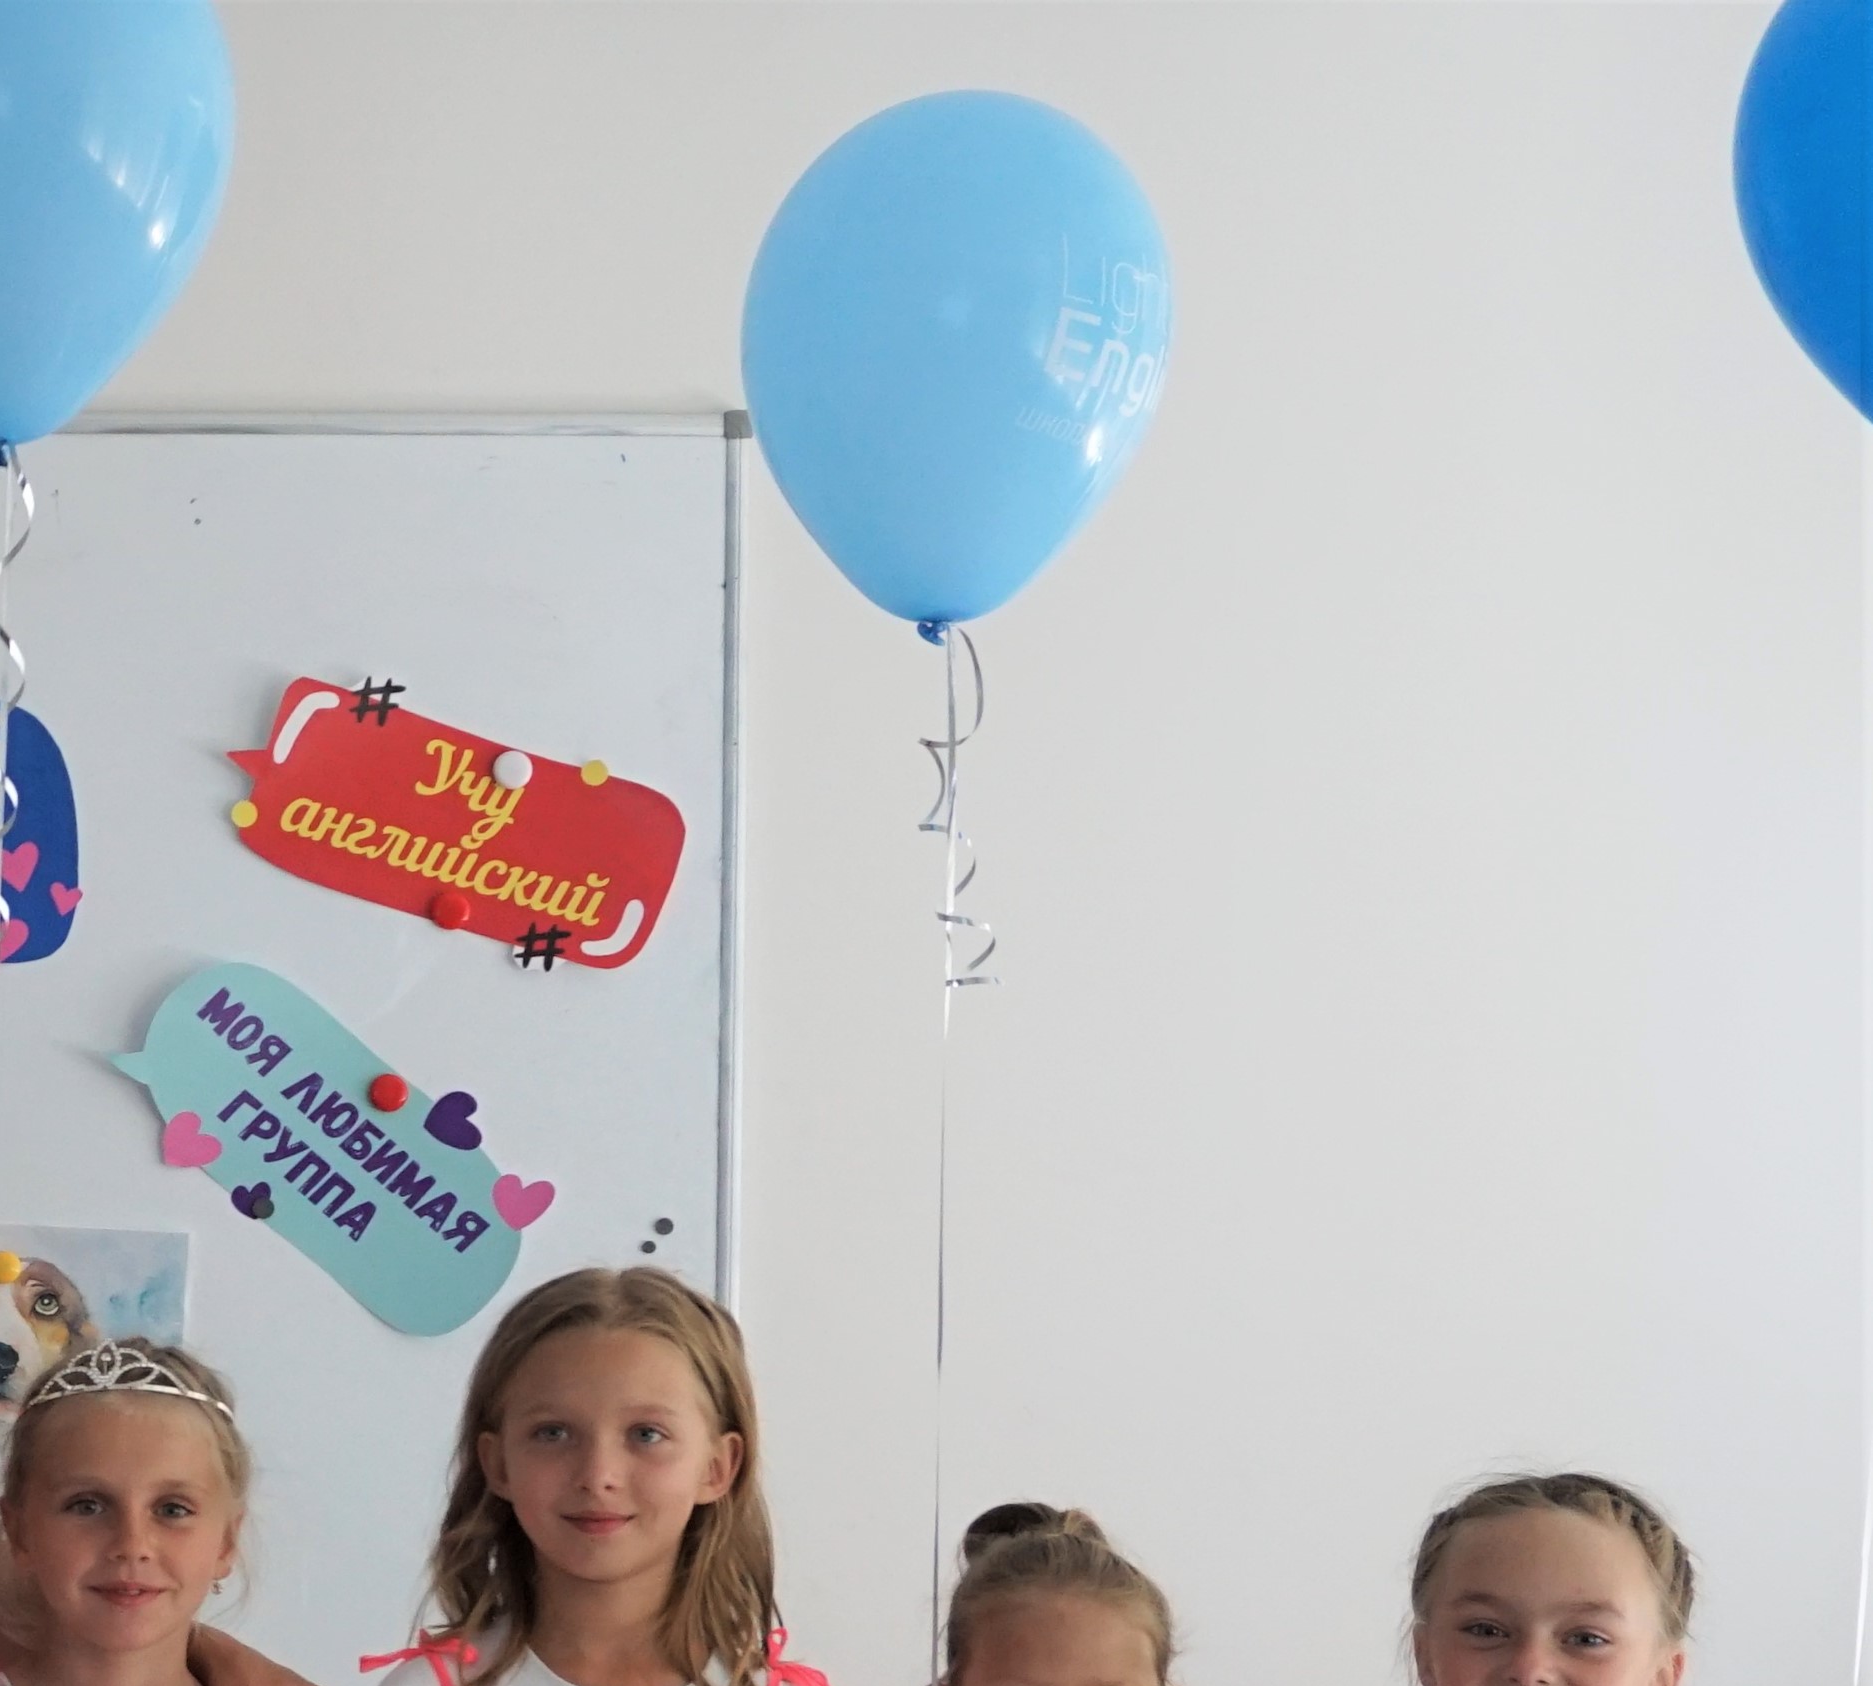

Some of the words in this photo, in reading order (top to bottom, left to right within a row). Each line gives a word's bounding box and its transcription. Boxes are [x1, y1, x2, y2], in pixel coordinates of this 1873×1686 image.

[279, 790, 610, 928] английский
[414, 739, 525, 839] Учу
[195, 986, 293, 1076] МОЯ
[283, 1072, 491, 1255] ЛЮБИМАЯ
[217, 1089, 379, 1244] ГРУППА
